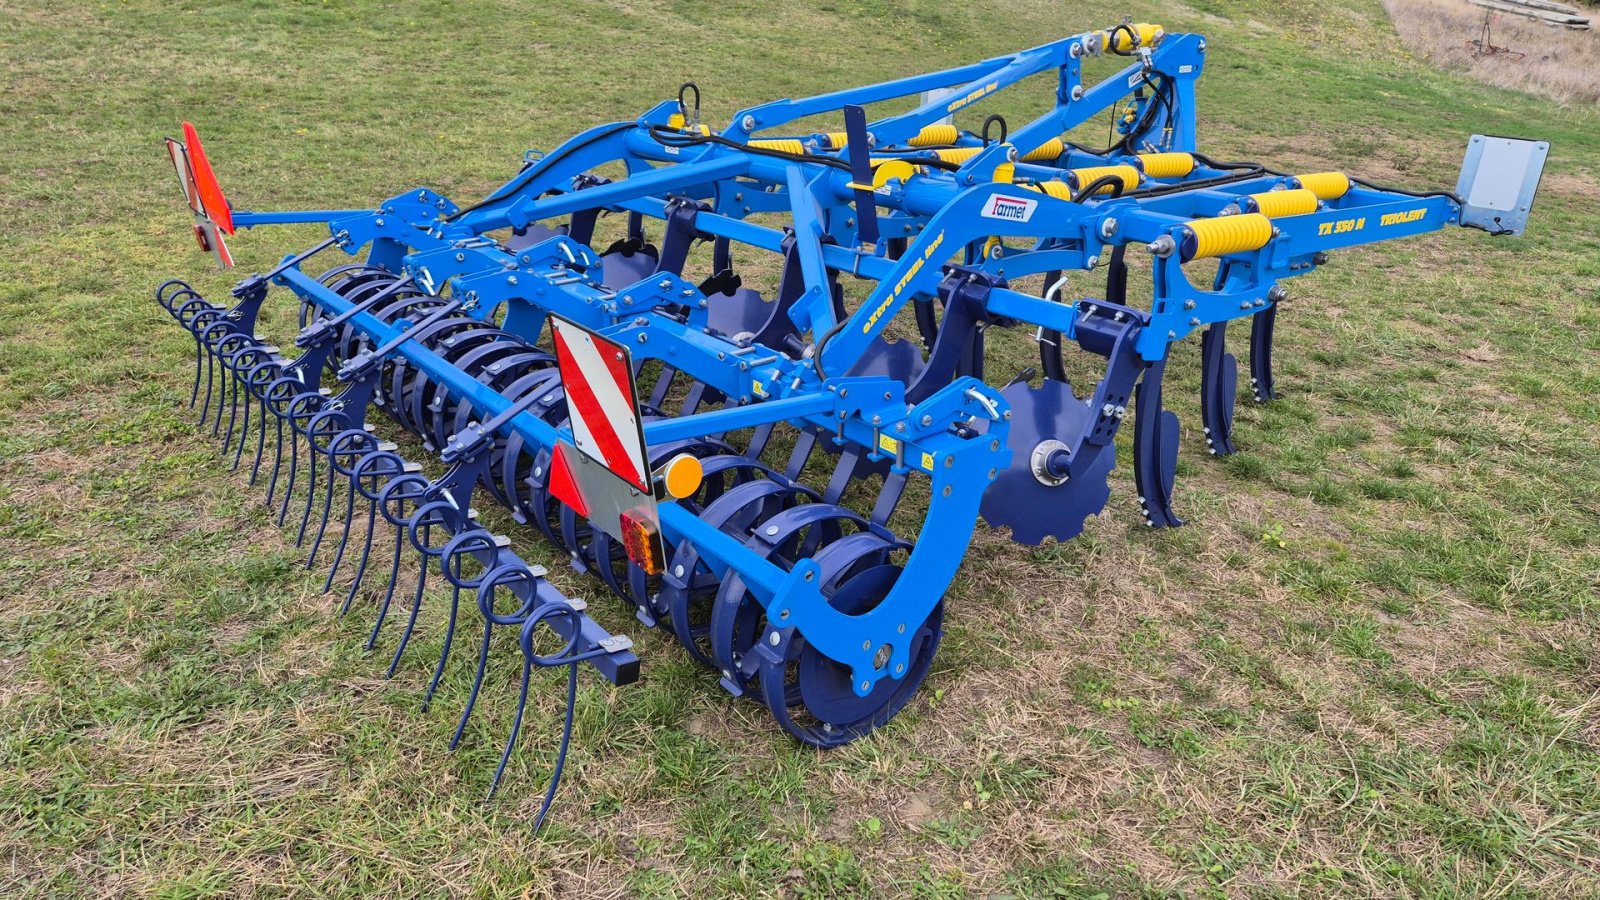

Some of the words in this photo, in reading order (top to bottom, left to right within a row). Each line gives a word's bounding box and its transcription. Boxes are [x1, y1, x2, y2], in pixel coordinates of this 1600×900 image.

[967, 87, 985, 103] STEEL
[992, 197, 1027, 219] Farmet
[1318, 222, 1334, 235] TX
[1334, 219, 1355, 234] 350
[1355, 217, 1366, 230] N
[1380, 208, 1427, 226] TRIOLENT
[894, 257, 924, 296] STEEL
